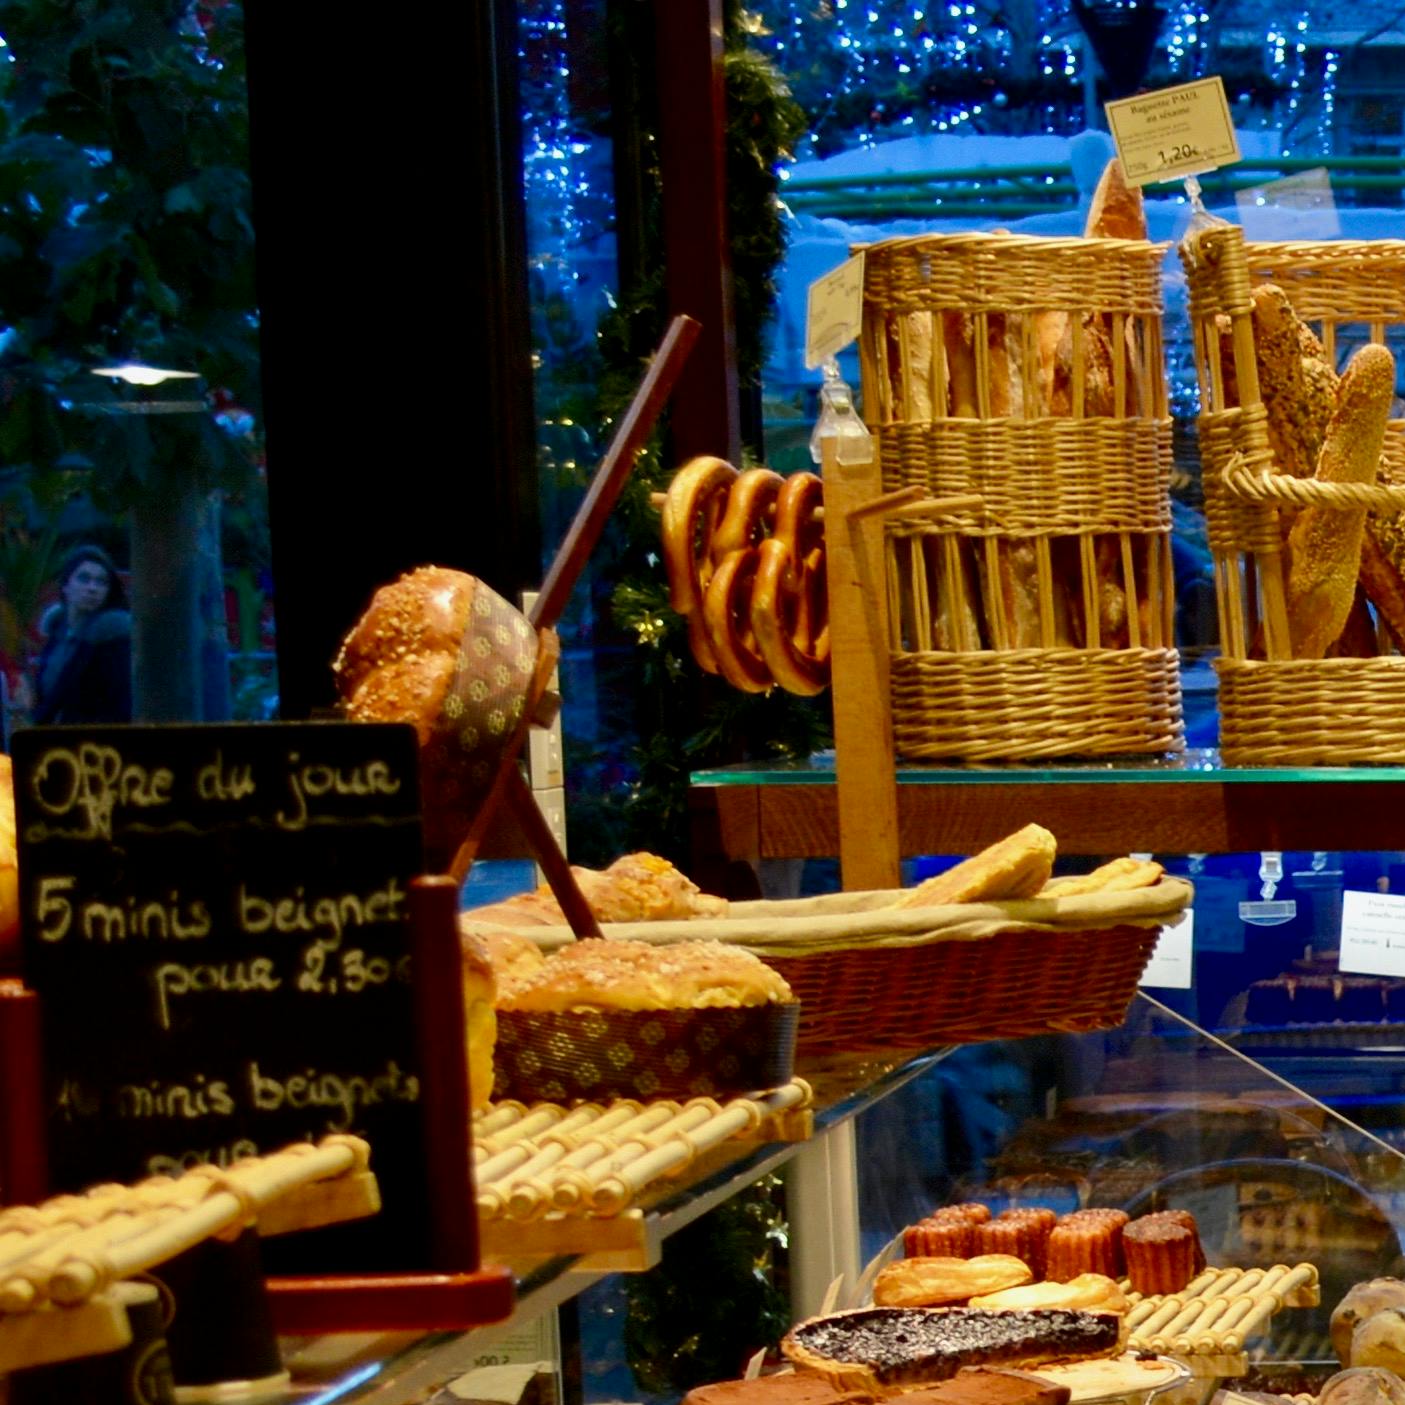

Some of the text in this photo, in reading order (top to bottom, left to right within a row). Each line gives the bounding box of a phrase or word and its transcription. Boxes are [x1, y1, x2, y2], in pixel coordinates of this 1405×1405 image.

[1130, 91, 1198, 115] Baguette PAUL
[199, 748, 256, 800] du
[37, 877, 76, 942] 5
[84, 889, 211, 942] minis
